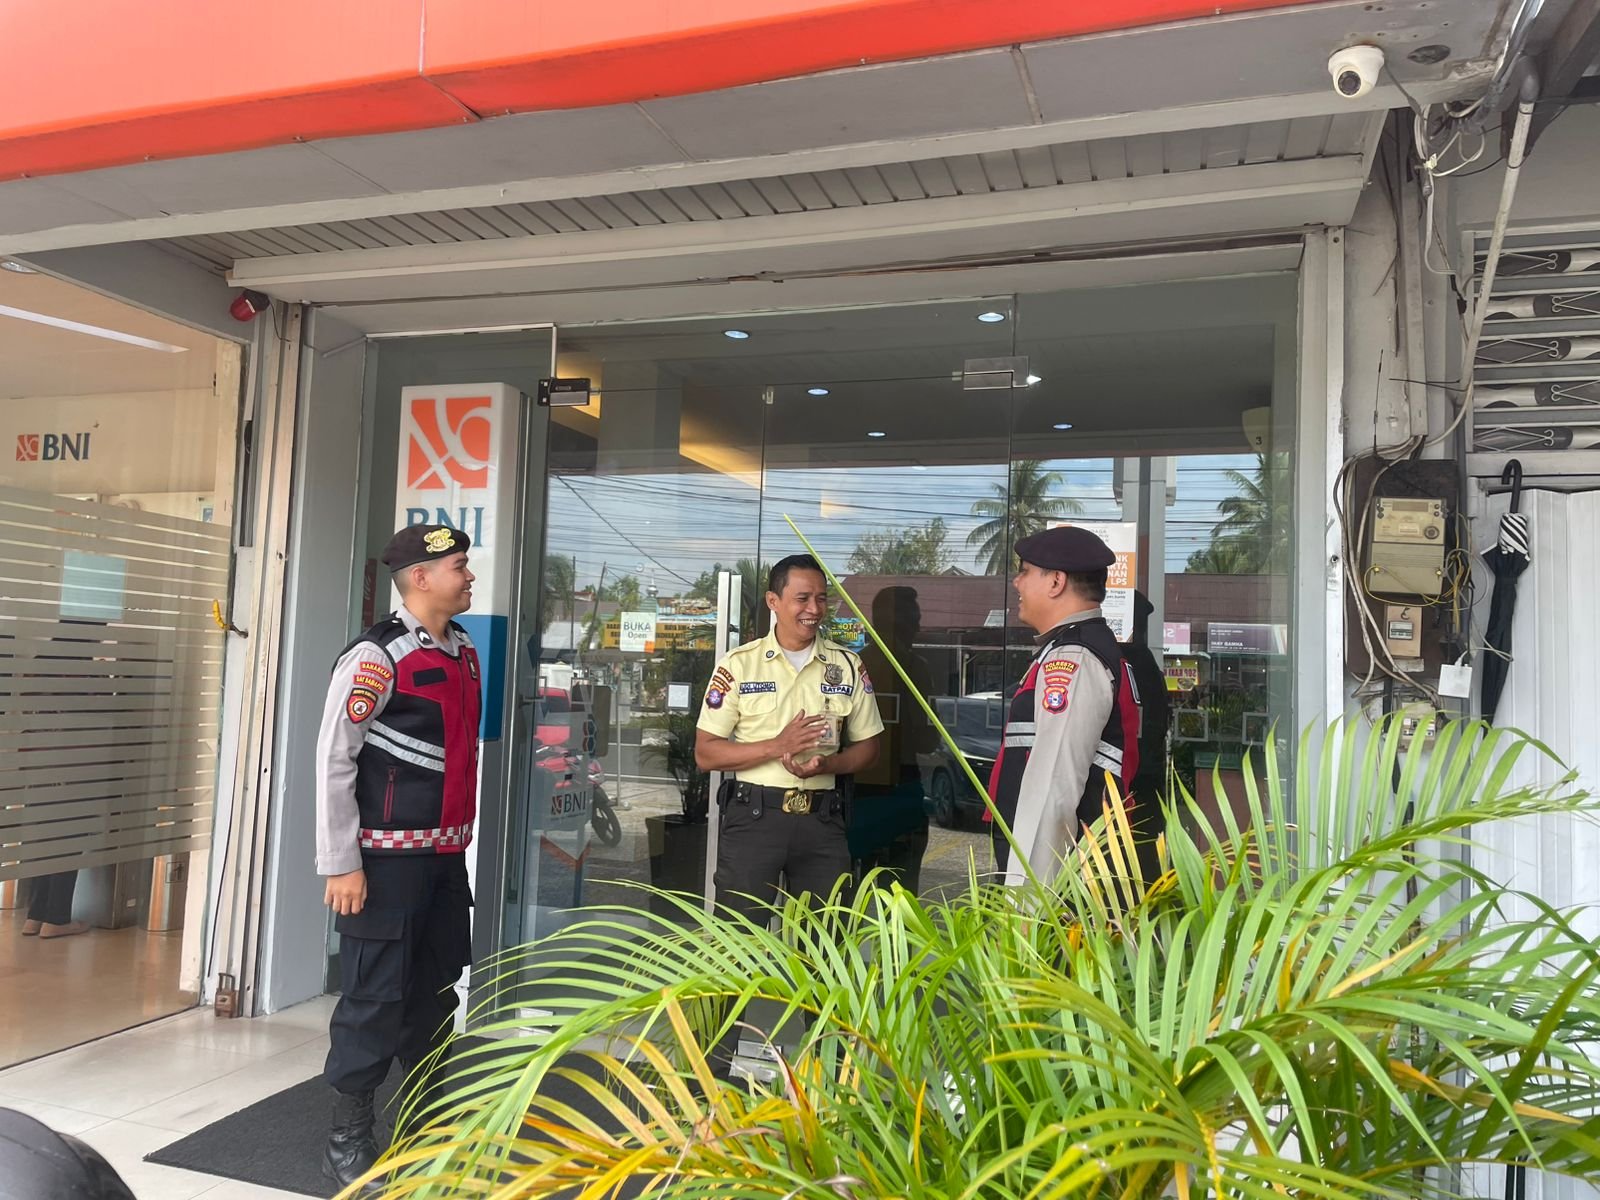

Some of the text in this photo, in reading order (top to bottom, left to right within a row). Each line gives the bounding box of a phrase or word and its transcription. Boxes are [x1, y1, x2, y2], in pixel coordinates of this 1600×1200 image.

[42, 432, 91, 461] BNI
[623, 622, 651, 631] BUKA
[627, 631, 648, 640] Open
[564, 791, 586, 813] BNI
